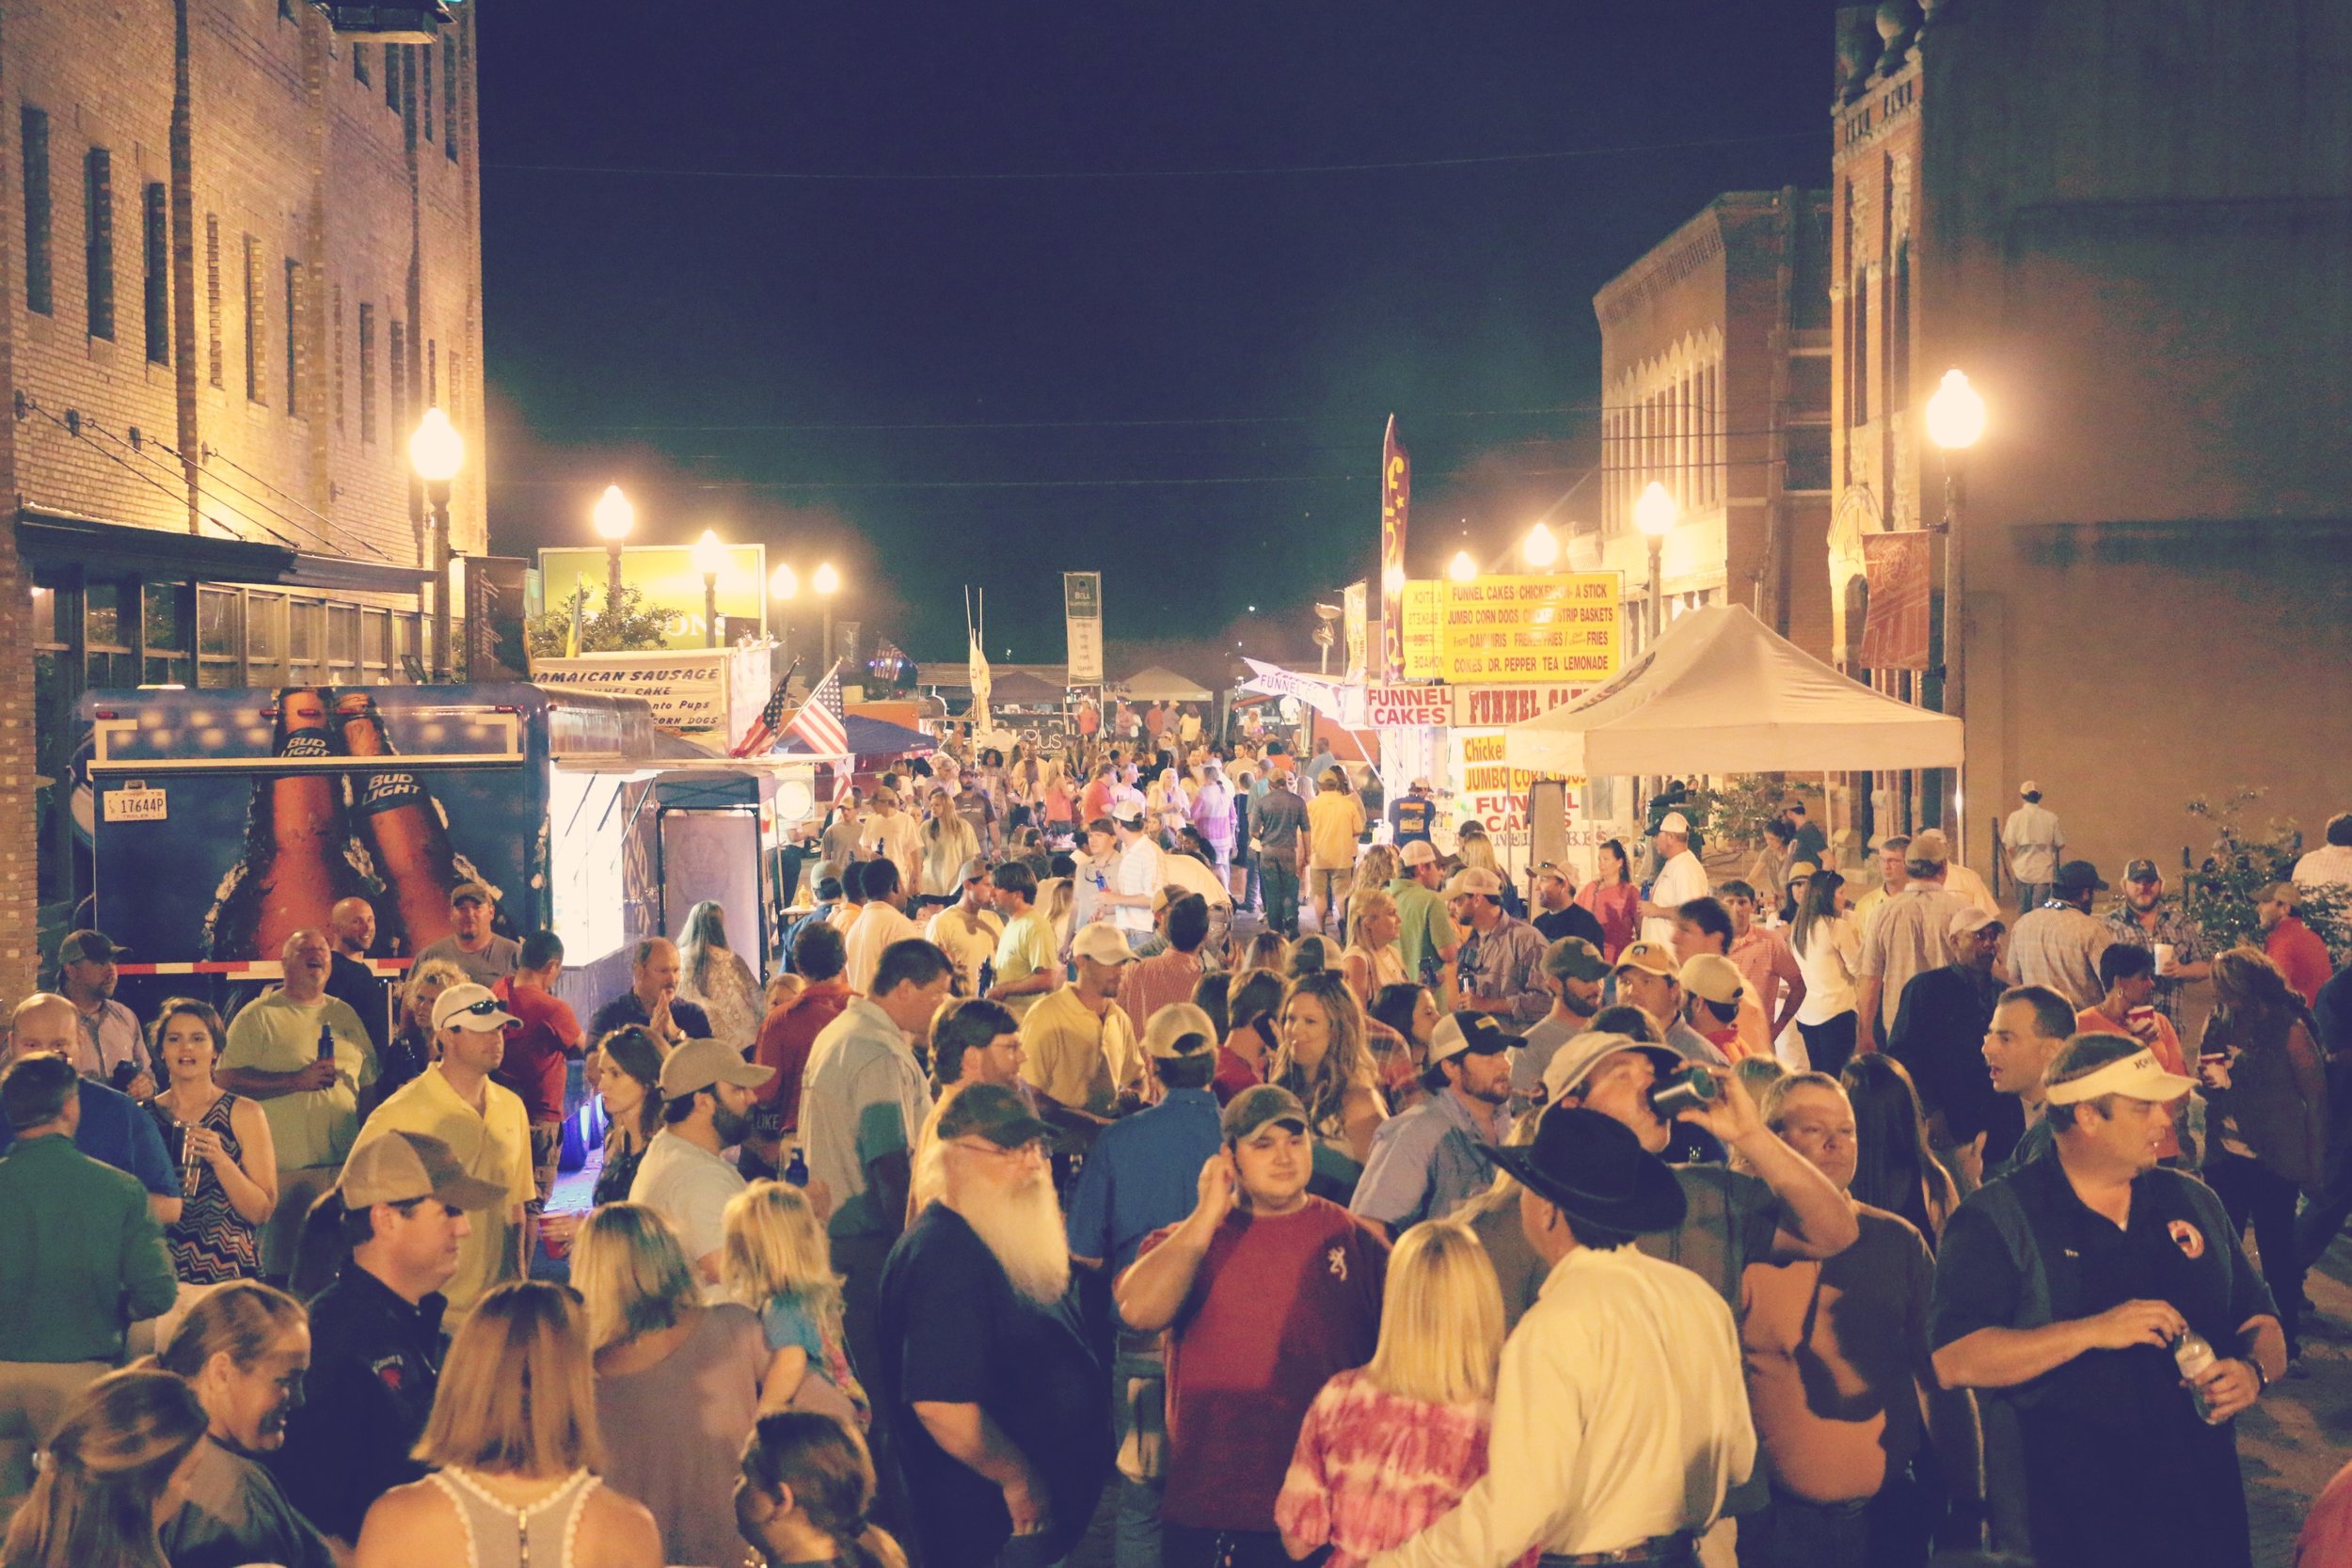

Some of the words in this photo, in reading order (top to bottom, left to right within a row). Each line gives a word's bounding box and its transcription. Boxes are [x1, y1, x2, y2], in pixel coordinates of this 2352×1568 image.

[480, 568, 500, 614] Main
[1453, 586, 1484, 601] FUNNEL
[1487, 586, 1515, 600] CAKES
[1575, 584, 1581, 599] A
[1583, 583, 1607, 598] STICK
[1448, 610, 1473, 625] JUMBO
[1476, 610, 1497, 624] CORN
[1499, 609, 1519, 624] DOGS
[1558, 608, 1579, 623] STRIP
[1581, 607, 1613, 622] BASKETS
[480, 618, 502, 662] Street
[1586, 630, 1608, 645] FRIES
[1454, 657, 1482, 673] COKES
[1488, 657, 1502, 672] DR.
[1504, 657, 1536, 672] PEPPER
[1543, 656, 1559, 671] TEA
[1564, 655, 1609, 671] LEMONADE
[629, 668, 719, 682] SAUSAGE
[634, 687, 672, 695] CAKE
[1261, 674, 1301, 697] FUNNEL
[679, 700, 709, 710] Pups
[1368, 688, 1452, 706] FUNNEL
[1470, 689, 1540, 723] FUNNEL
[1375, 707, 1446, 724] CAKES
[287, 736, 326, 749] BUD
[1465, 736, 1505, 762] Chicke
[369, 773, 414, 789] BUD
[1467, 767, 1509, 791] JUMBO
[362, 784, 421, 805] LIGHT
[121, 799, 164, 814] 17644P
[1476, 793, 1579, 815] FUNL
